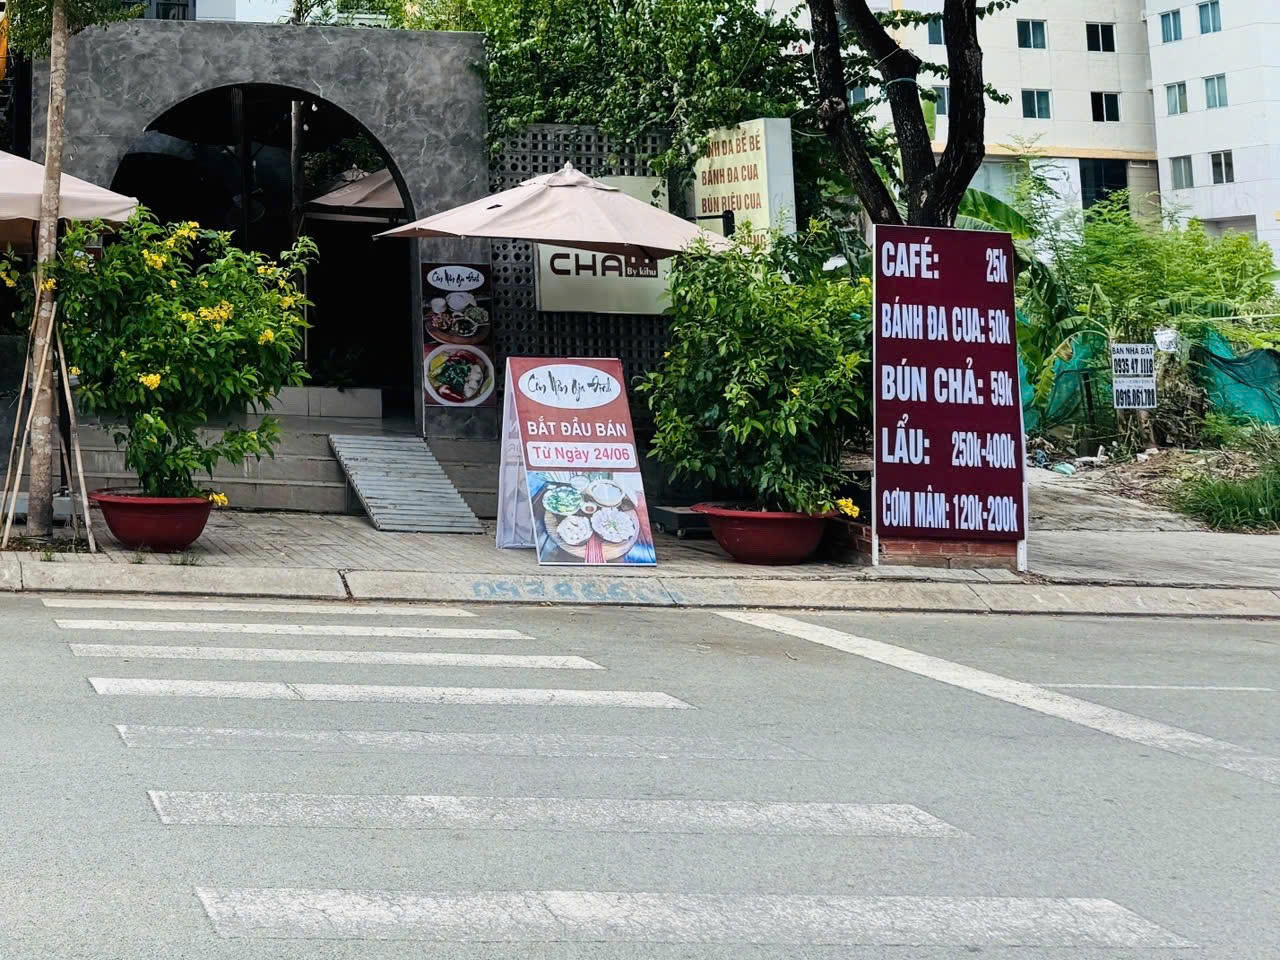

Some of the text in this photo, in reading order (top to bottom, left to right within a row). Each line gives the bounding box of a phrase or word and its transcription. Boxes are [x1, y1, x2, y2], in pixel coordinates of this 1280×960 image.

[701, 163, 759, 186] BÁNH ĐA CUA
[701, 193, 720, 213] BÚN
[744, 193, 762, 209] CUA
[627, 267, 637, 278] By
[881, 236, 1008, 283] CAFÉ: 25k
[881, 296, 1011, 344] BÁNH ĐA CUA: 50k
[881, 357, 1014, 406] BÚN CHẢ: 59k
[527, 416, 556, 436] BẮT
[561, 416, 592, 437] ĐẦU
[595, 420, 628, 437] BÁN
[881, 413, 1017, 469] LẨU: 250k-400k
[532, 445, 552, 459] Từ
[554, 446, 590, 463] Ngày
[593, 447, 630, 460] 24/06
[882, 484, 1019, 532] CƠM MÂM: 120k-200k
